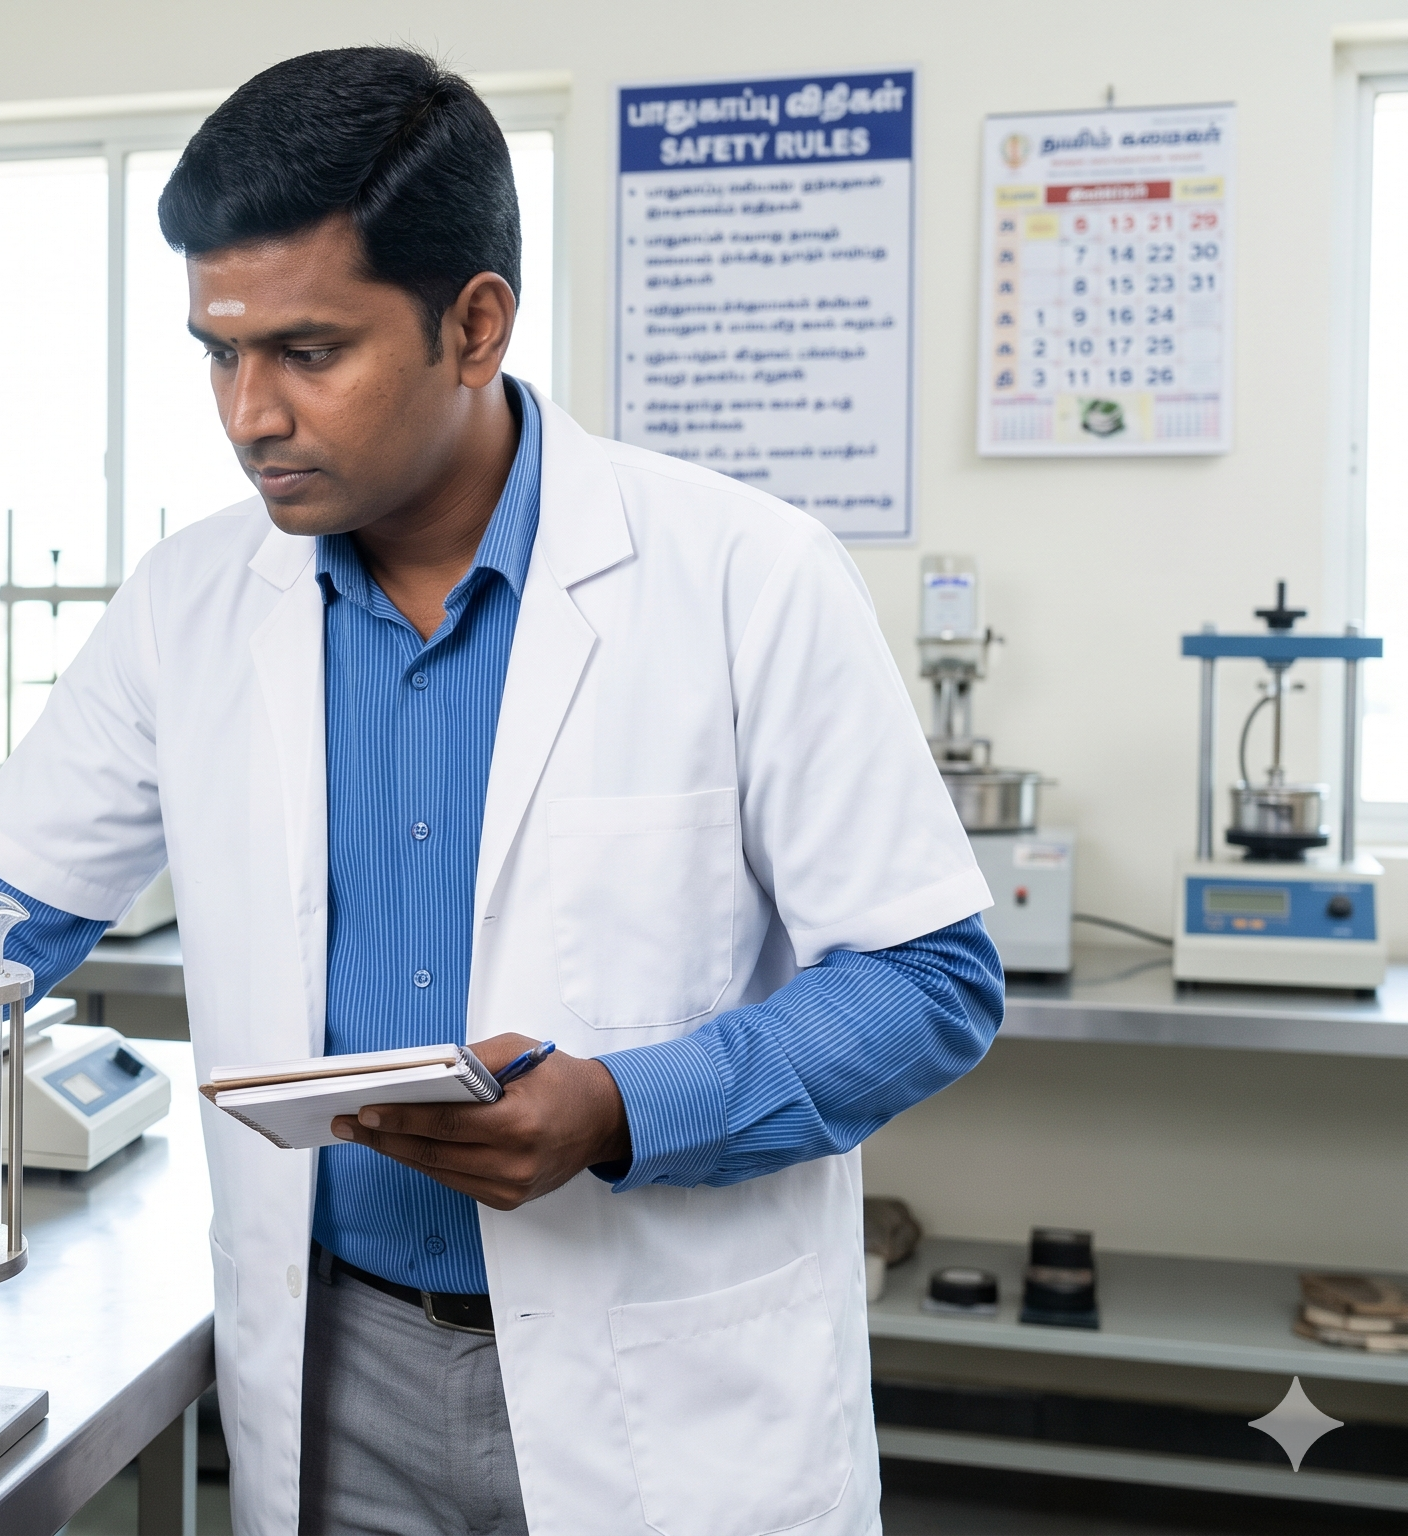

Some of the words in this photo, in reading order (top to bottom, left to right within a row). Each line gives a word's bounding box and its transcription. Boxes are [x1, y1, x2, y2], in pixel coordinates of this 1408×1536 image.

[627, 87, 780, 135] பாதுகாப்பு
[785, 78, 907, 124] விதிகள்
[659, 132, 770, 165] SAFETY
[774, 127, 871, 160] RULES
[1147, 211, 1175, 232] 21
[1074, 244, 1089, 263] 7
[1108, 245, 1136, 263] 14
[1146, 243, 1176, 264] 22
[1189, 240, 1220, 261] 30
[1108, 274, 1135, 294] 15
[1146, 272, 1176, 294] 23
[1189, 271, 1216, 292] 31
[1035, 308, 1046, 327] 1
[1107, 306, 1135, 326] 16
[1146, 304, 1176, 325] 24
[1032, 338, 1047, 358] 2
[1067, 337, 1094, 357] 10
[1107, 336, 1134, 355] 17
[1146, 335, 1176, 356] 25
[1032, 367, 1047, 388] 3
[1067, 367, 1092, 386] 11
[1145, 365, 1176, 387] 26
